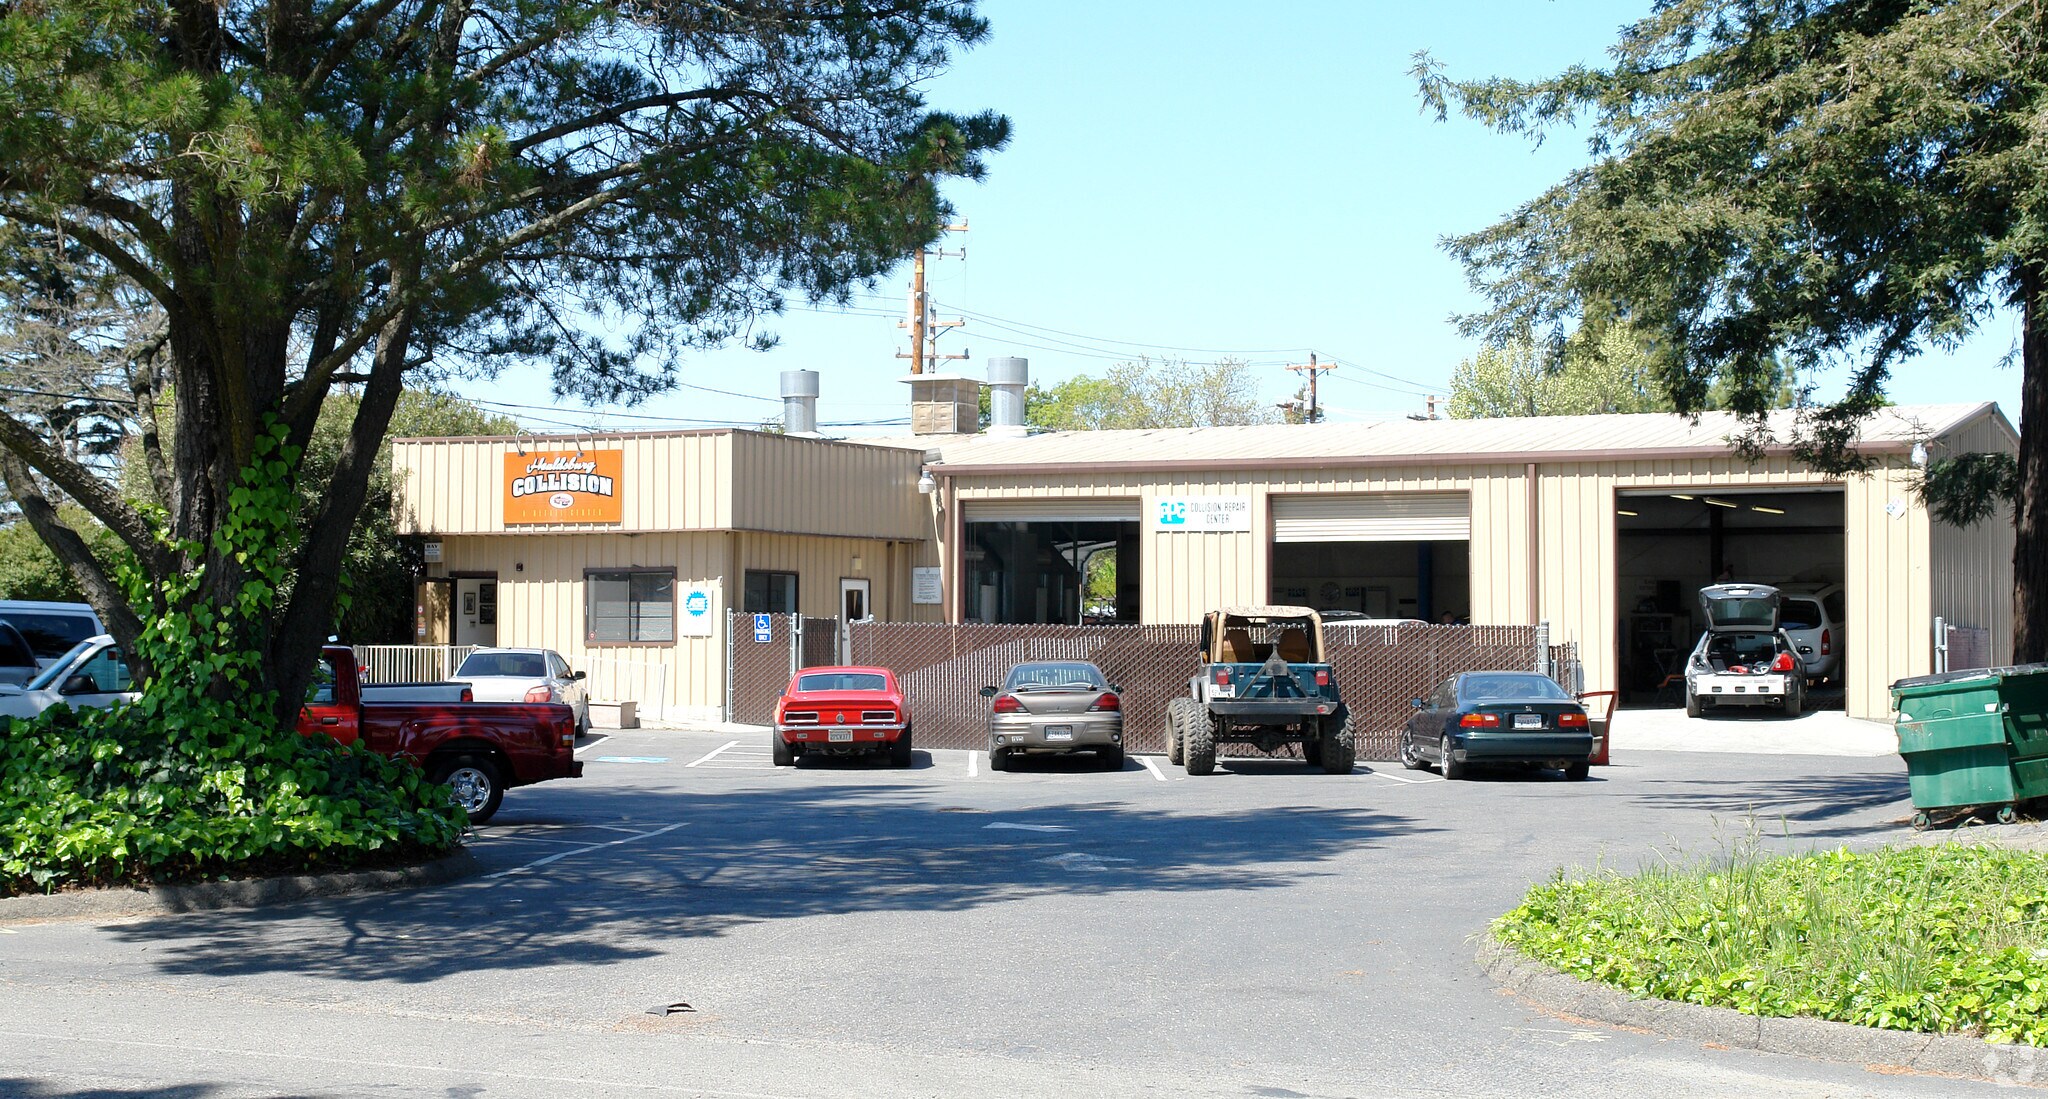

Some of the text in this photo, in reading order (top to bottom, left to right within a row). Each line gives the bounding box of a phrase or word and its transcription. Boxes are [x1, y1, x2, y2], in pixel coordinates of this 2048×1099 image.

[527, 457, 596, 474] Healdsburg
[512, 473, 613, 497] COLLISION
[1161, 501, 1246, 522] PPG COLLISION REPAIR
[1206, 513, 1230, 524] CENTER
